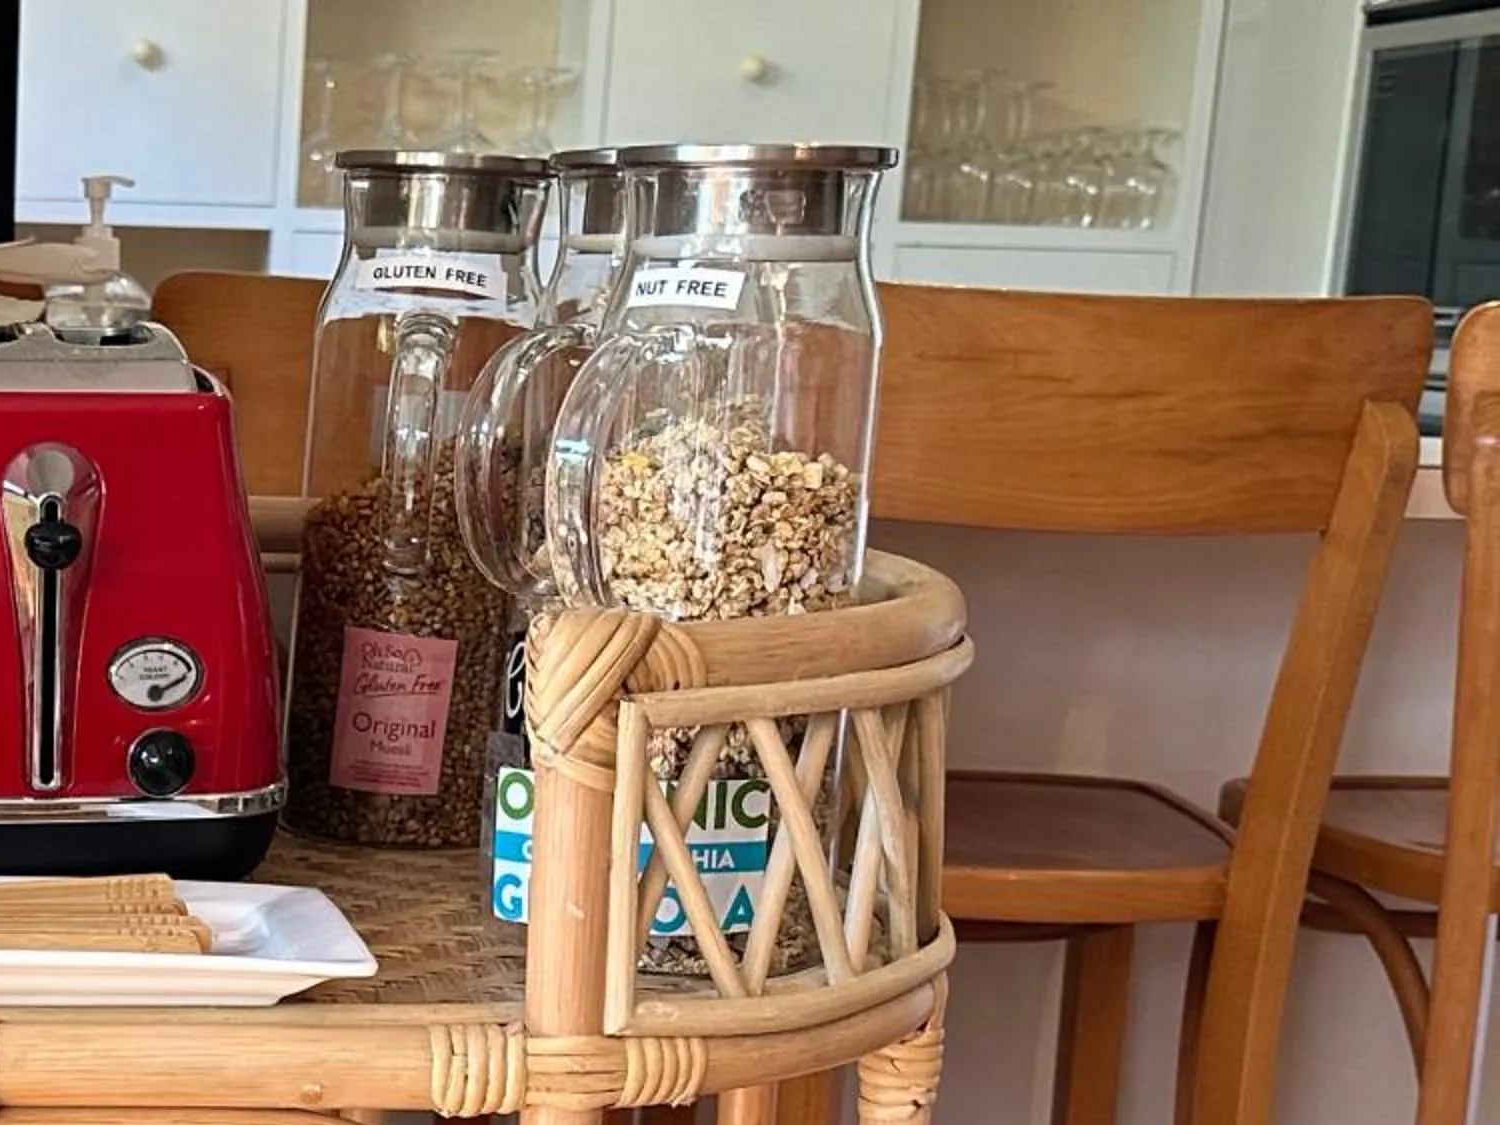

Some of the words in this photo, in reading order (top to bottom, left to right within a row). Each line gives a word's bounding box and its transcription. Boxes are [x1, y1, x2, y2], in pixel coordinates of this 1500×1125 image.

[373, 264, 437, 281] GLUTEN
[445, 268, 487, 288] FREE
[635, 280, 667, 297] NUT
[675, 280, 727, 299] FREE
[353, 672, 408, 695] Gluten
[411, 673, 447, 694] Free
[352, 711, 436, 742] Original
[692, 849, 736, 870] HIA
